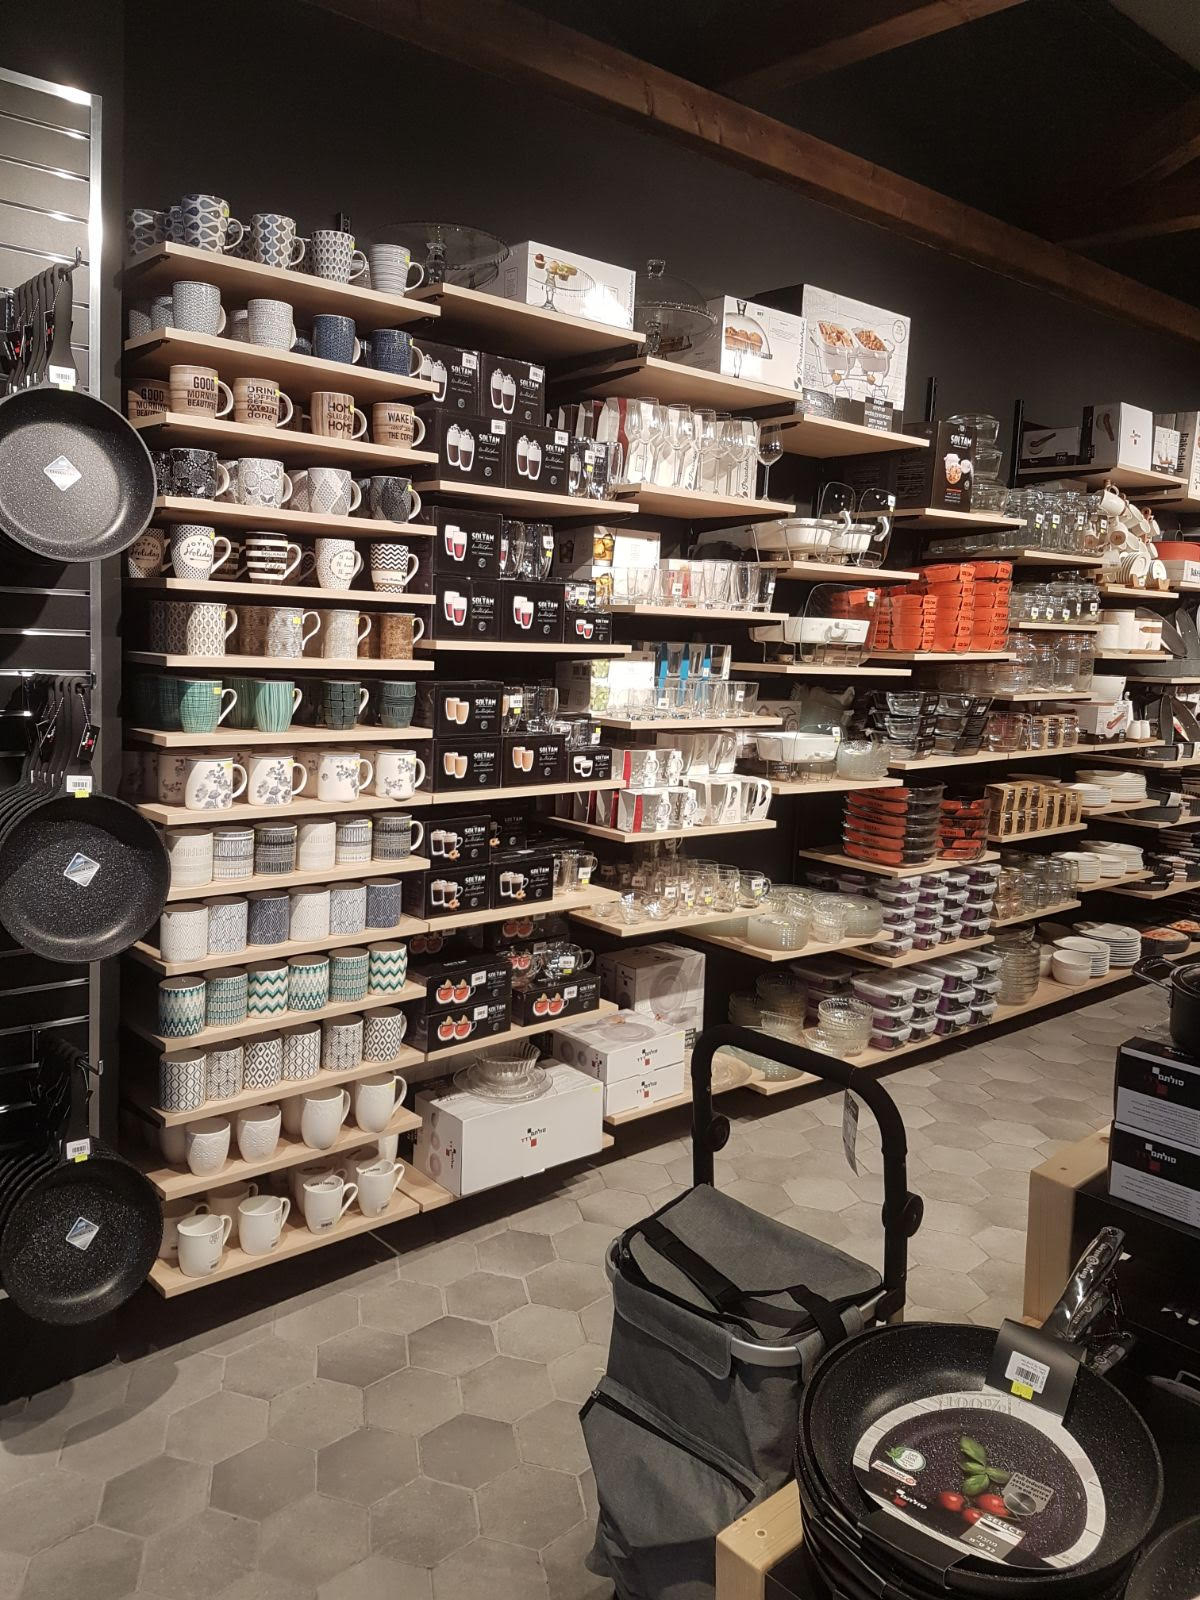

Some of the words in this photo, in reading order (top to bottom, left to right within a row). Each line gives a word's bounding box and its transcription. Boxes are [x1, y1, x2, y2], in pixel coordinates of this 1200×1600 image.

[193, 376, 215, 391] GOOD
[141, 388, 164, 401] GOOD
[136, 400, 168, 412] MORNING
[247, 410, 273, 421] done
[328, 420, 352, 434] HOME
[951, 434, 972, 447] SOLTAM
[471, 532, 495, 541] SOLTAM
[471, 597, 495, 606] SOLTAM
[475, 698, 497, 706] SOLTAM
[473, 752, 495, 760] SOLTAM
[1158, 1073, 1184, 1087] סולתם
[1151, 1150, 1177, 1164] סולתם
[986, 1514, 1022, 1535] SELECT
